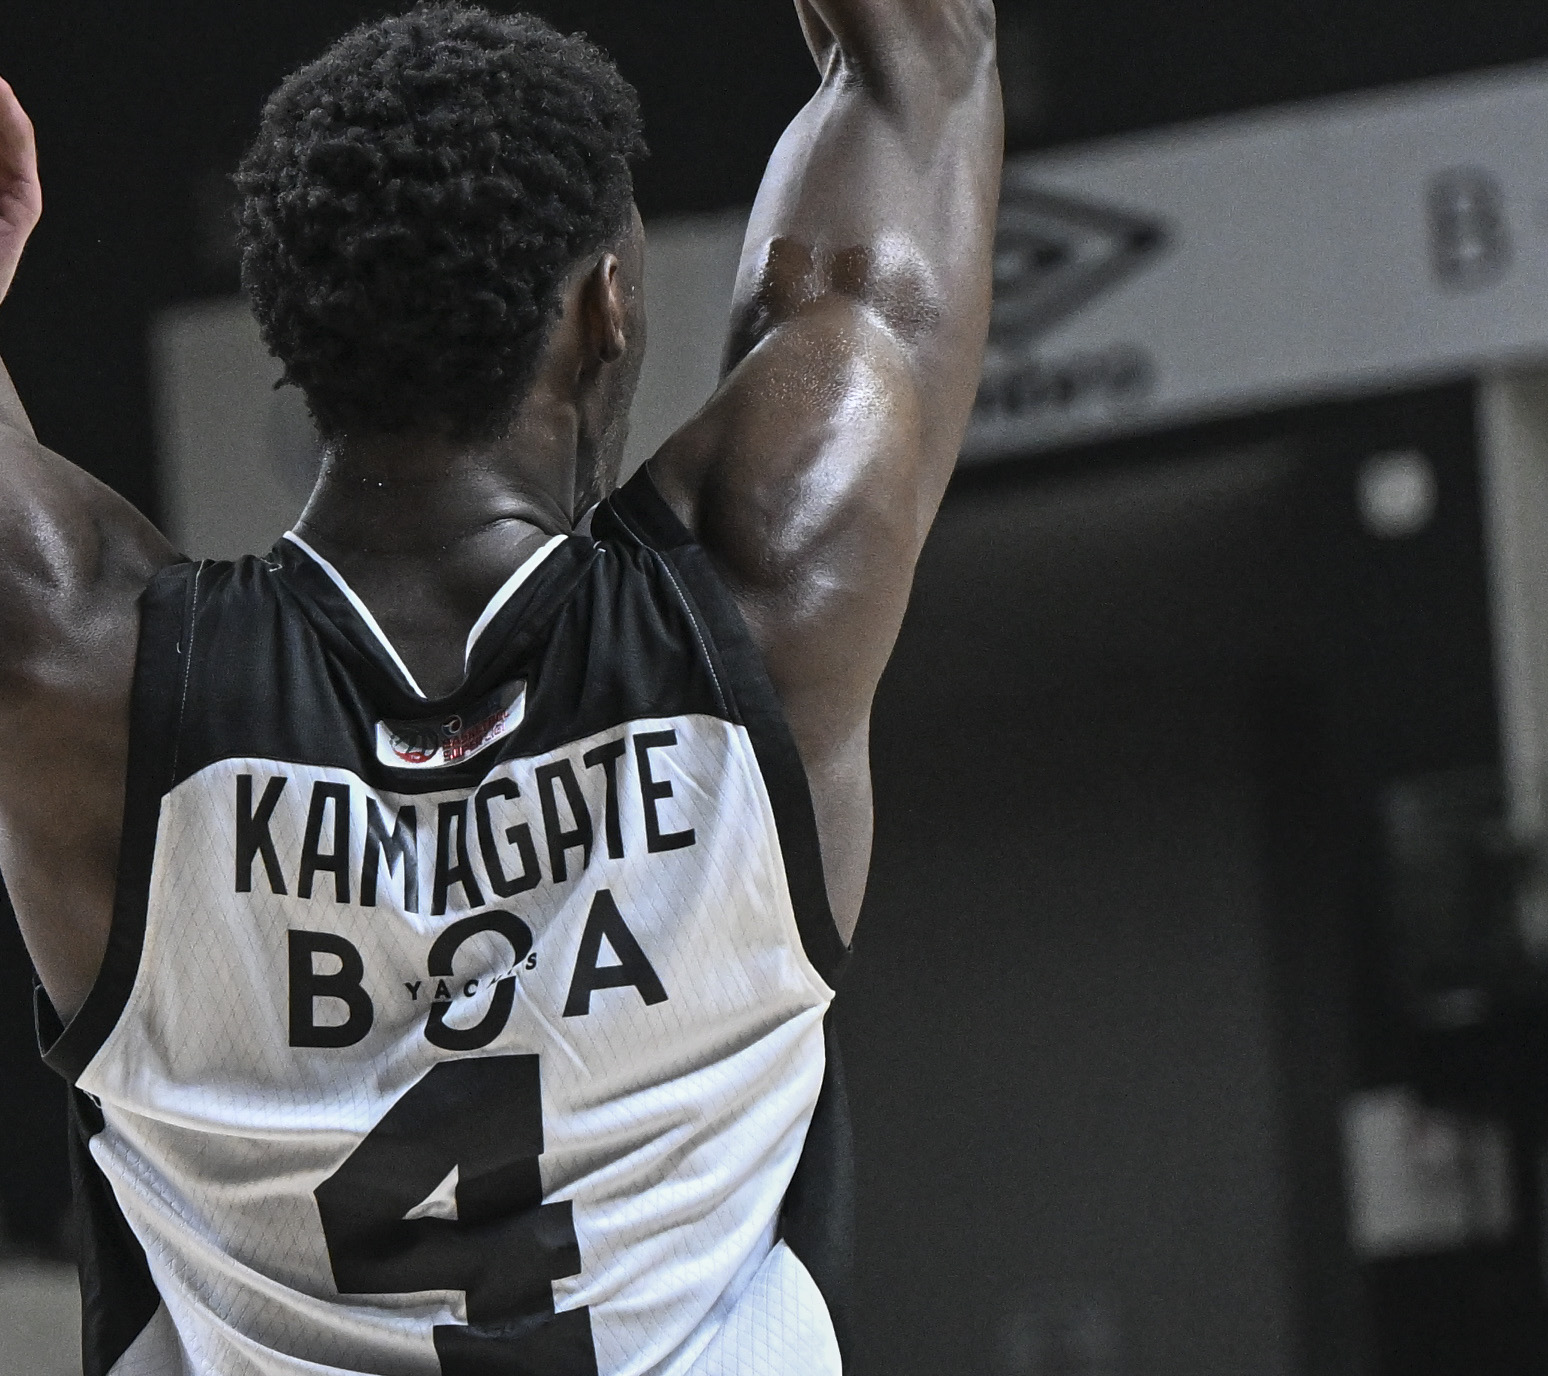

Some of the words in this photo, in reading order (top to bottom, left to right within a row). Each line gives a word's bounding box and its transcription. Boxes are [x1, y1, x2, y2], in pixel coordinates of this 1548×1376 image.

[235, 729, 697, 917] KAMAGATE
[288, 889, 669, 1052] BOA
[404, 951, 539, 1002] YACS
